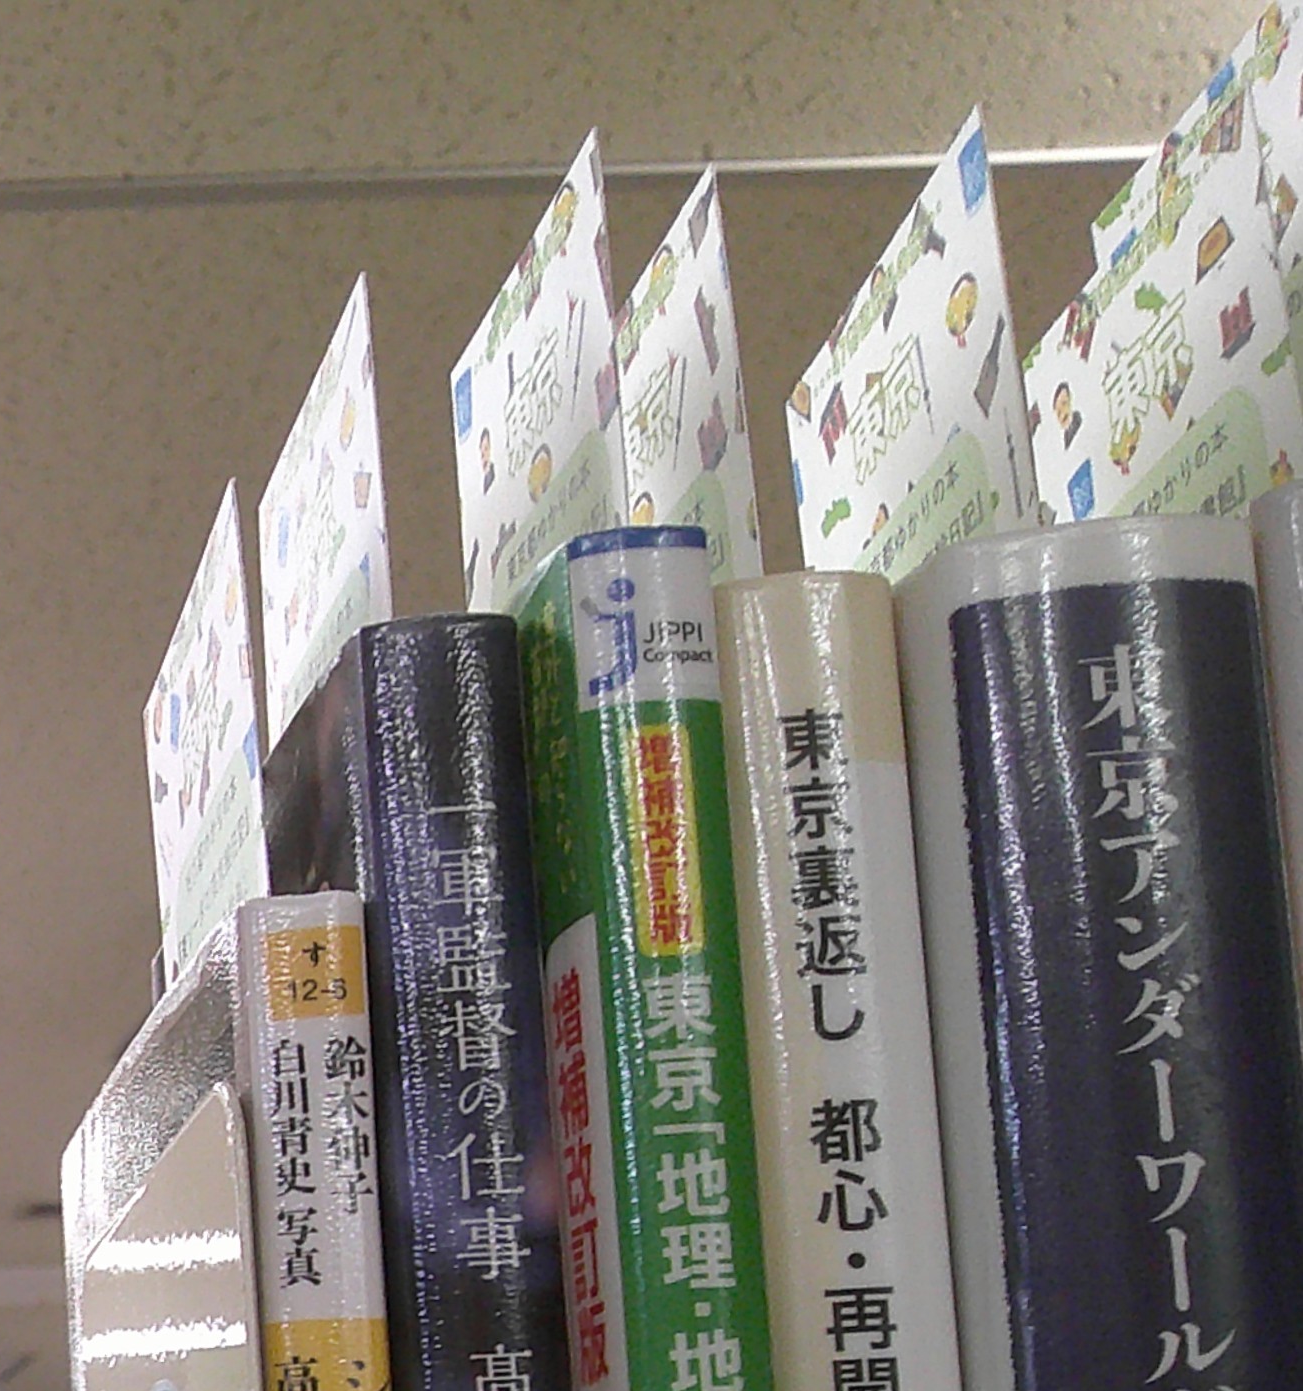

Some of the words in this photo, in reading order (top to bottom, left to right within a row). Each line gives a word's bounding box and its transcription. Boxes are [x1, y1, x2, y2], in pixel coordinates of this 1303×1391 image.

[504, 327, 563, 478] 東京
[849, 332, 921, 486] 東京
[1102, 288, 1194, 446] 東京
[643, 620, 704, 646] JIPPI
[781, 707, 869, 1043] 東京裏返し
[426, 798, 531, 1282] 一軍監督の仕事
[275, 1207, 323, 1290] 写真
